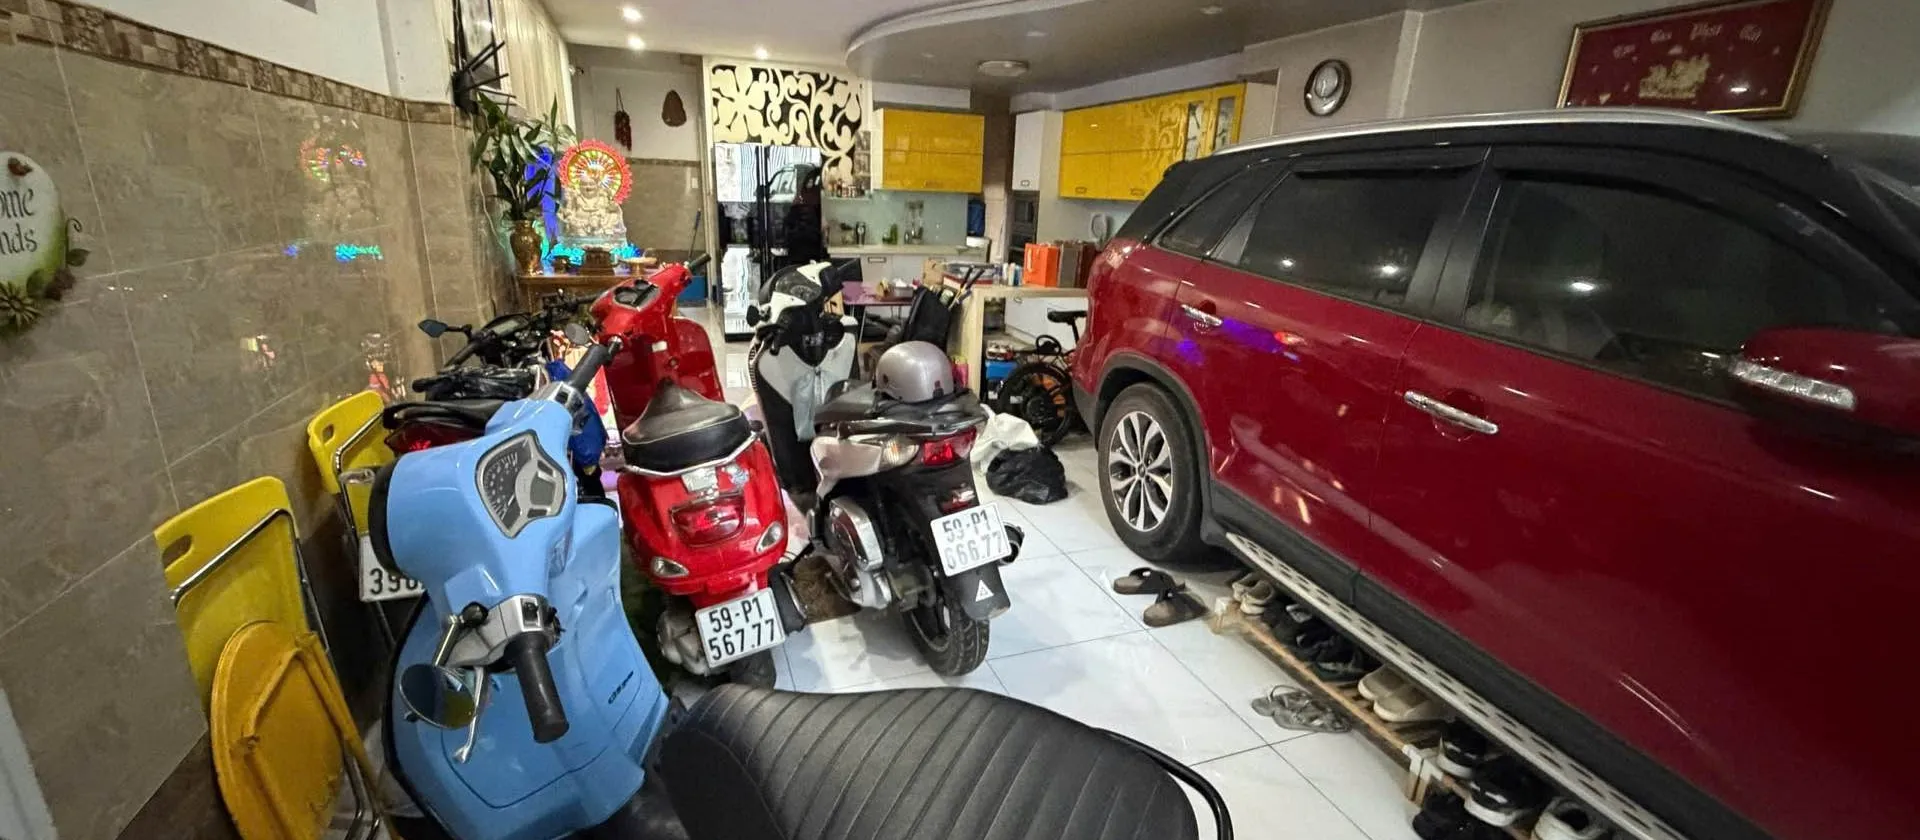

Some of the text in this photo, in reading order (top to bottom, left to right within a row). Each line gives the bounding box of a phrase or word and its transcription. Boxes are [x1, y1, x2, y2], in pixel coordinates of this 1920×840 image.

[941, 508, 991, 543] 59-P1
[708, 597, 763, 633] 59-P1
[707, 618, 775, 661] 567.77
